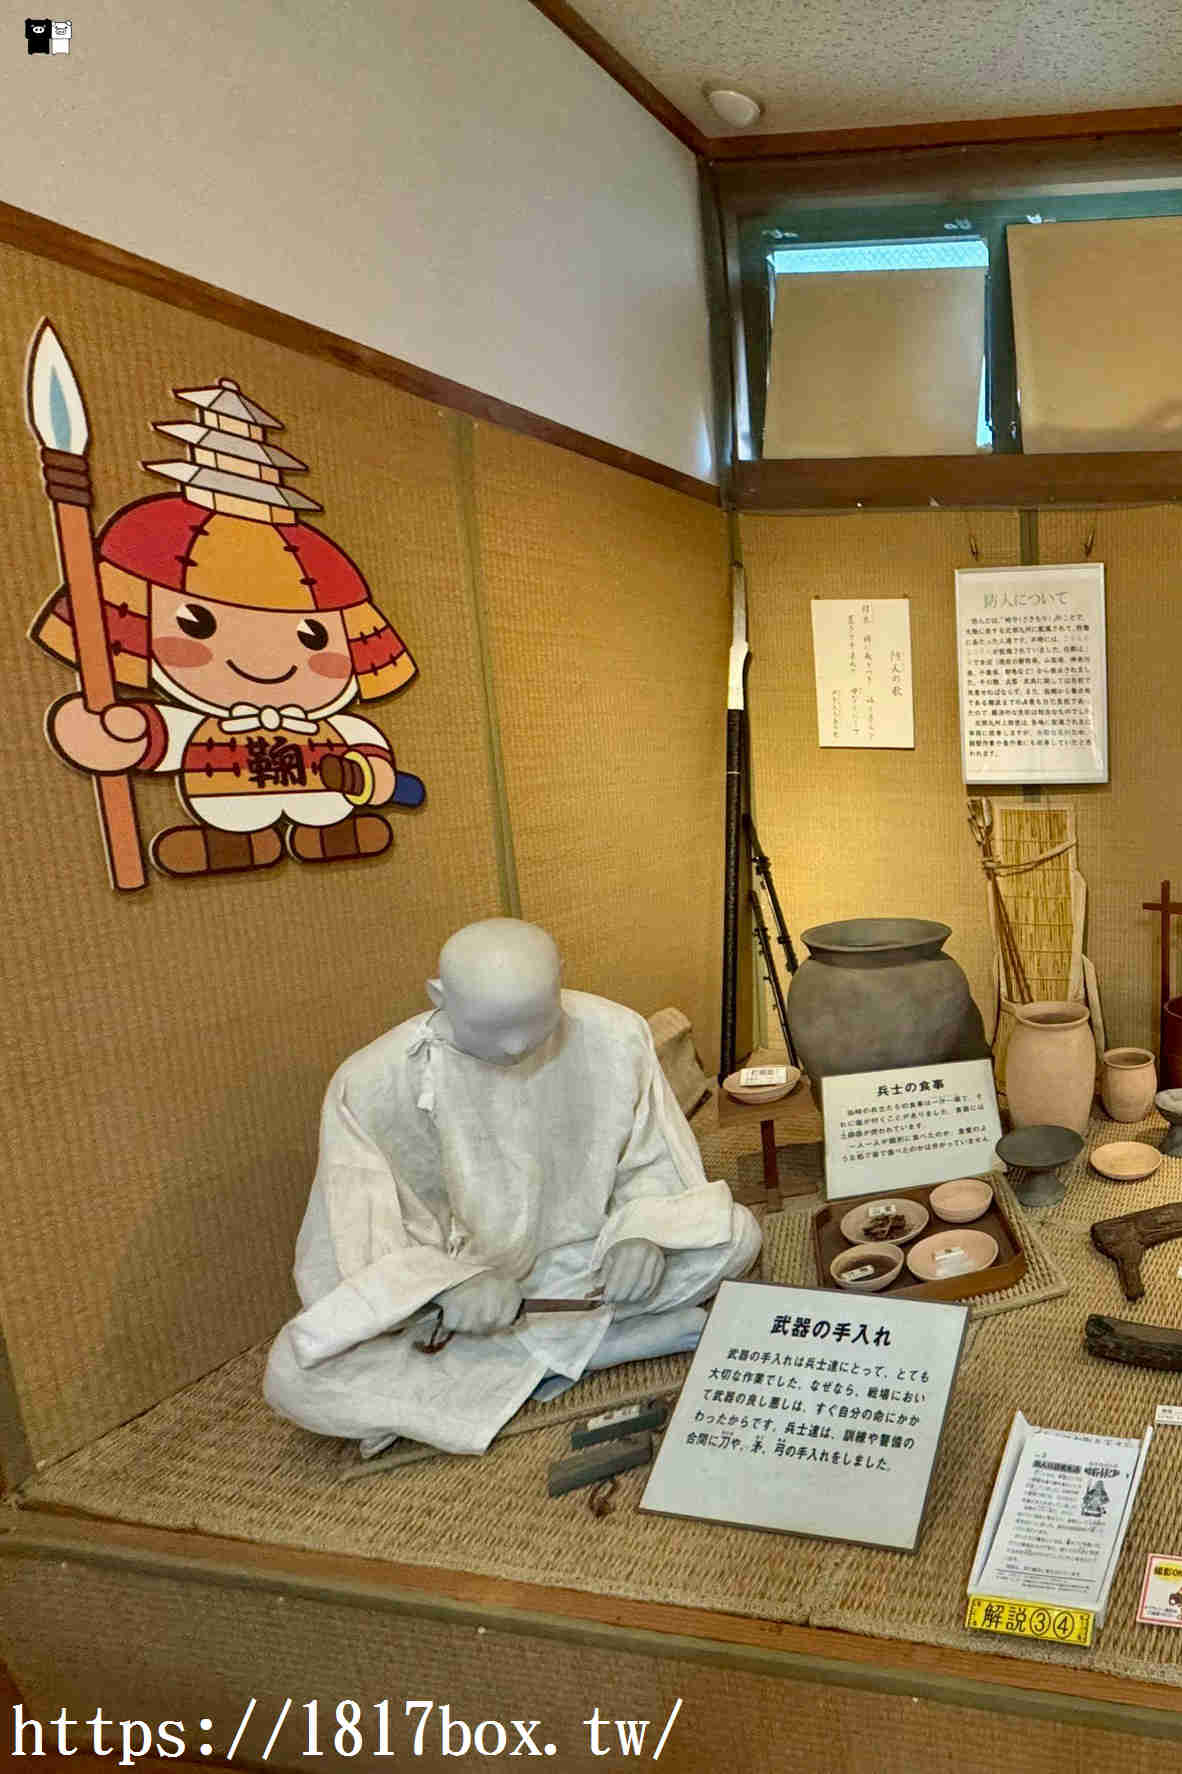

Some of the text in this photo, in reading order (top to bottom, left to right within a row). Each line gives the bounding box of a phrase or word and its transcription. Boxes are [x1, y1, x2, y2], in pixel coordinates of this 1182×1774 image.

[983, 591, 1070, 609] 防人について
[246, 735, 307, 789] 鞠
[876, 1078, 945, 1097] 兵士の食事
[770, 1314, 892, 1347] 武器の手入れ
